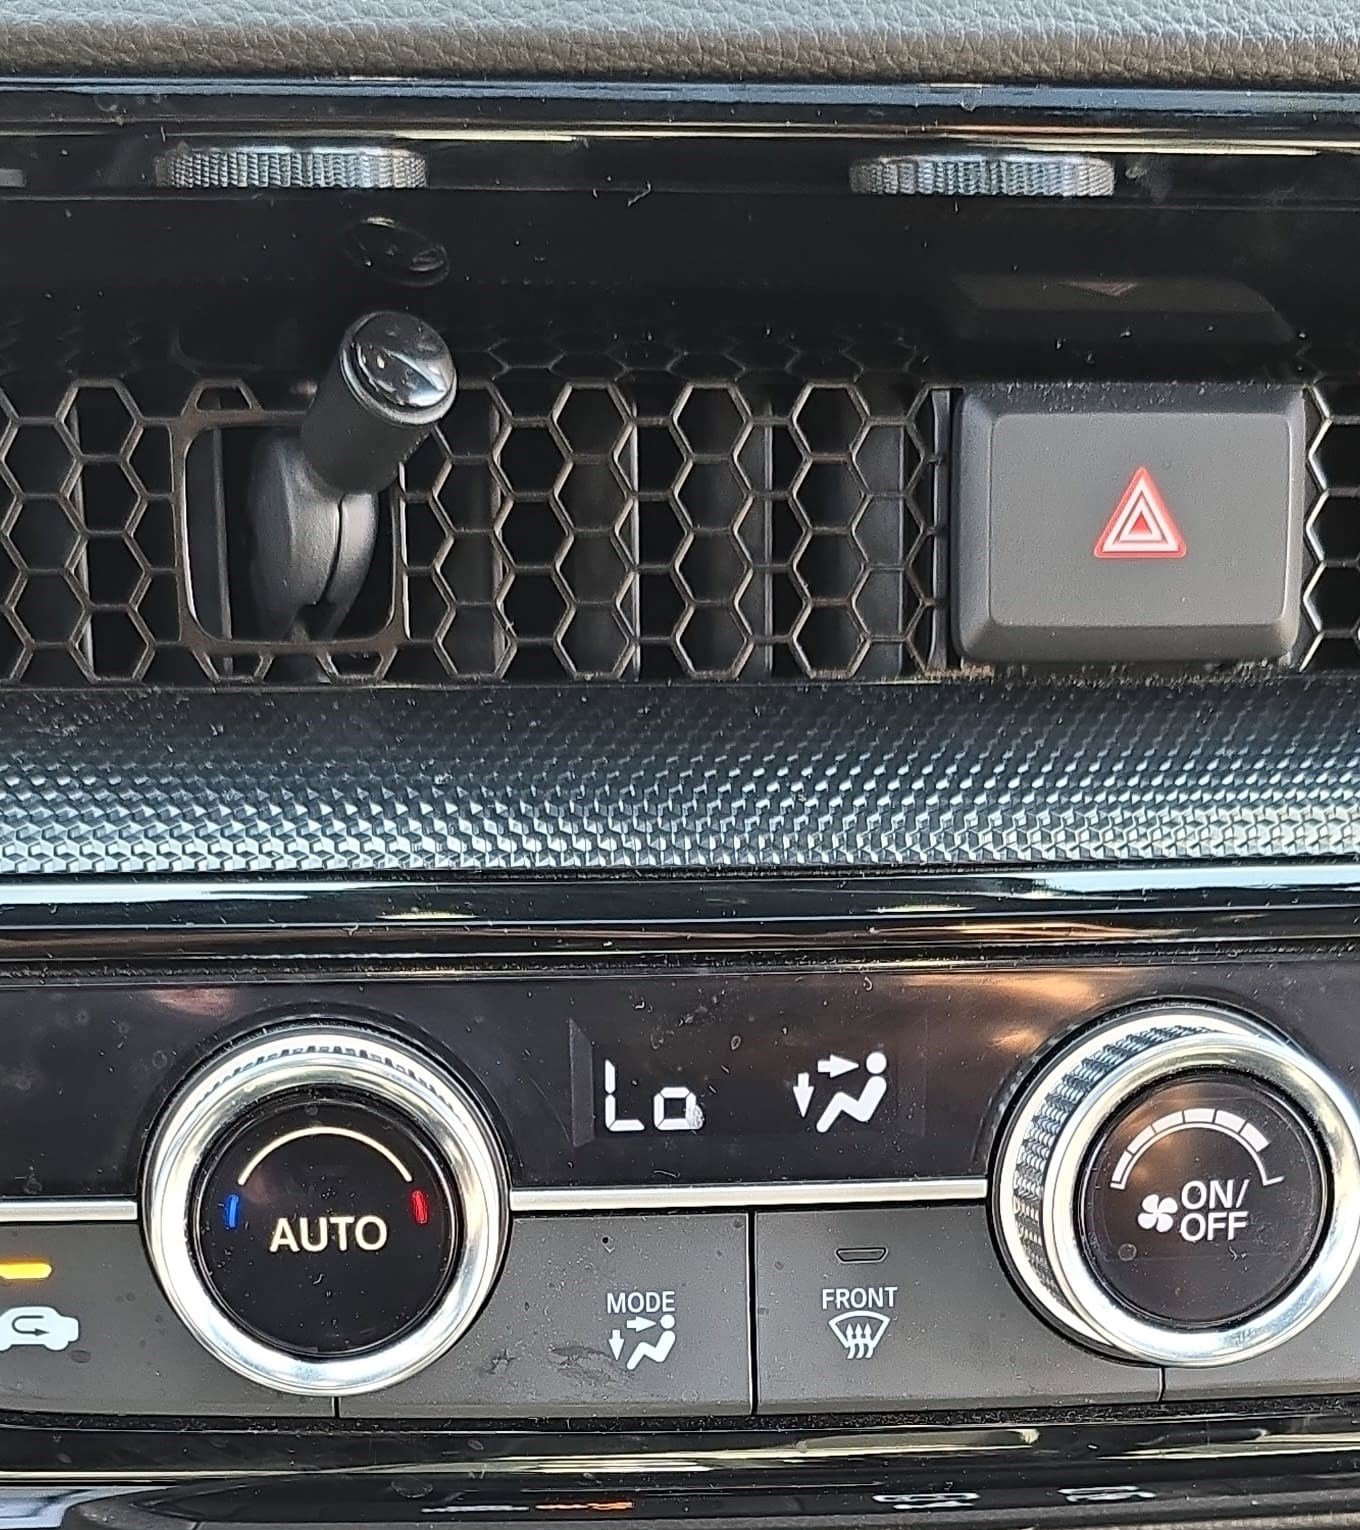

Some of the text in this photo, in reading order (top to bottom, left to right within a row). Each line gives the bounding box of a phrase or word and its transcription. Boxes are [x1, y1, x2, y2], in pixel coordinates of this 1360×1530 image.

[1178, 1176, 1252, 1210] ON/
[268, 1214, 388, 1252] AUTO
[1178, 1210, 1252, 1244] OFF
[606, 1290, 676, 1314] MODE
[820, 1286, 900, 1310] FRONT
